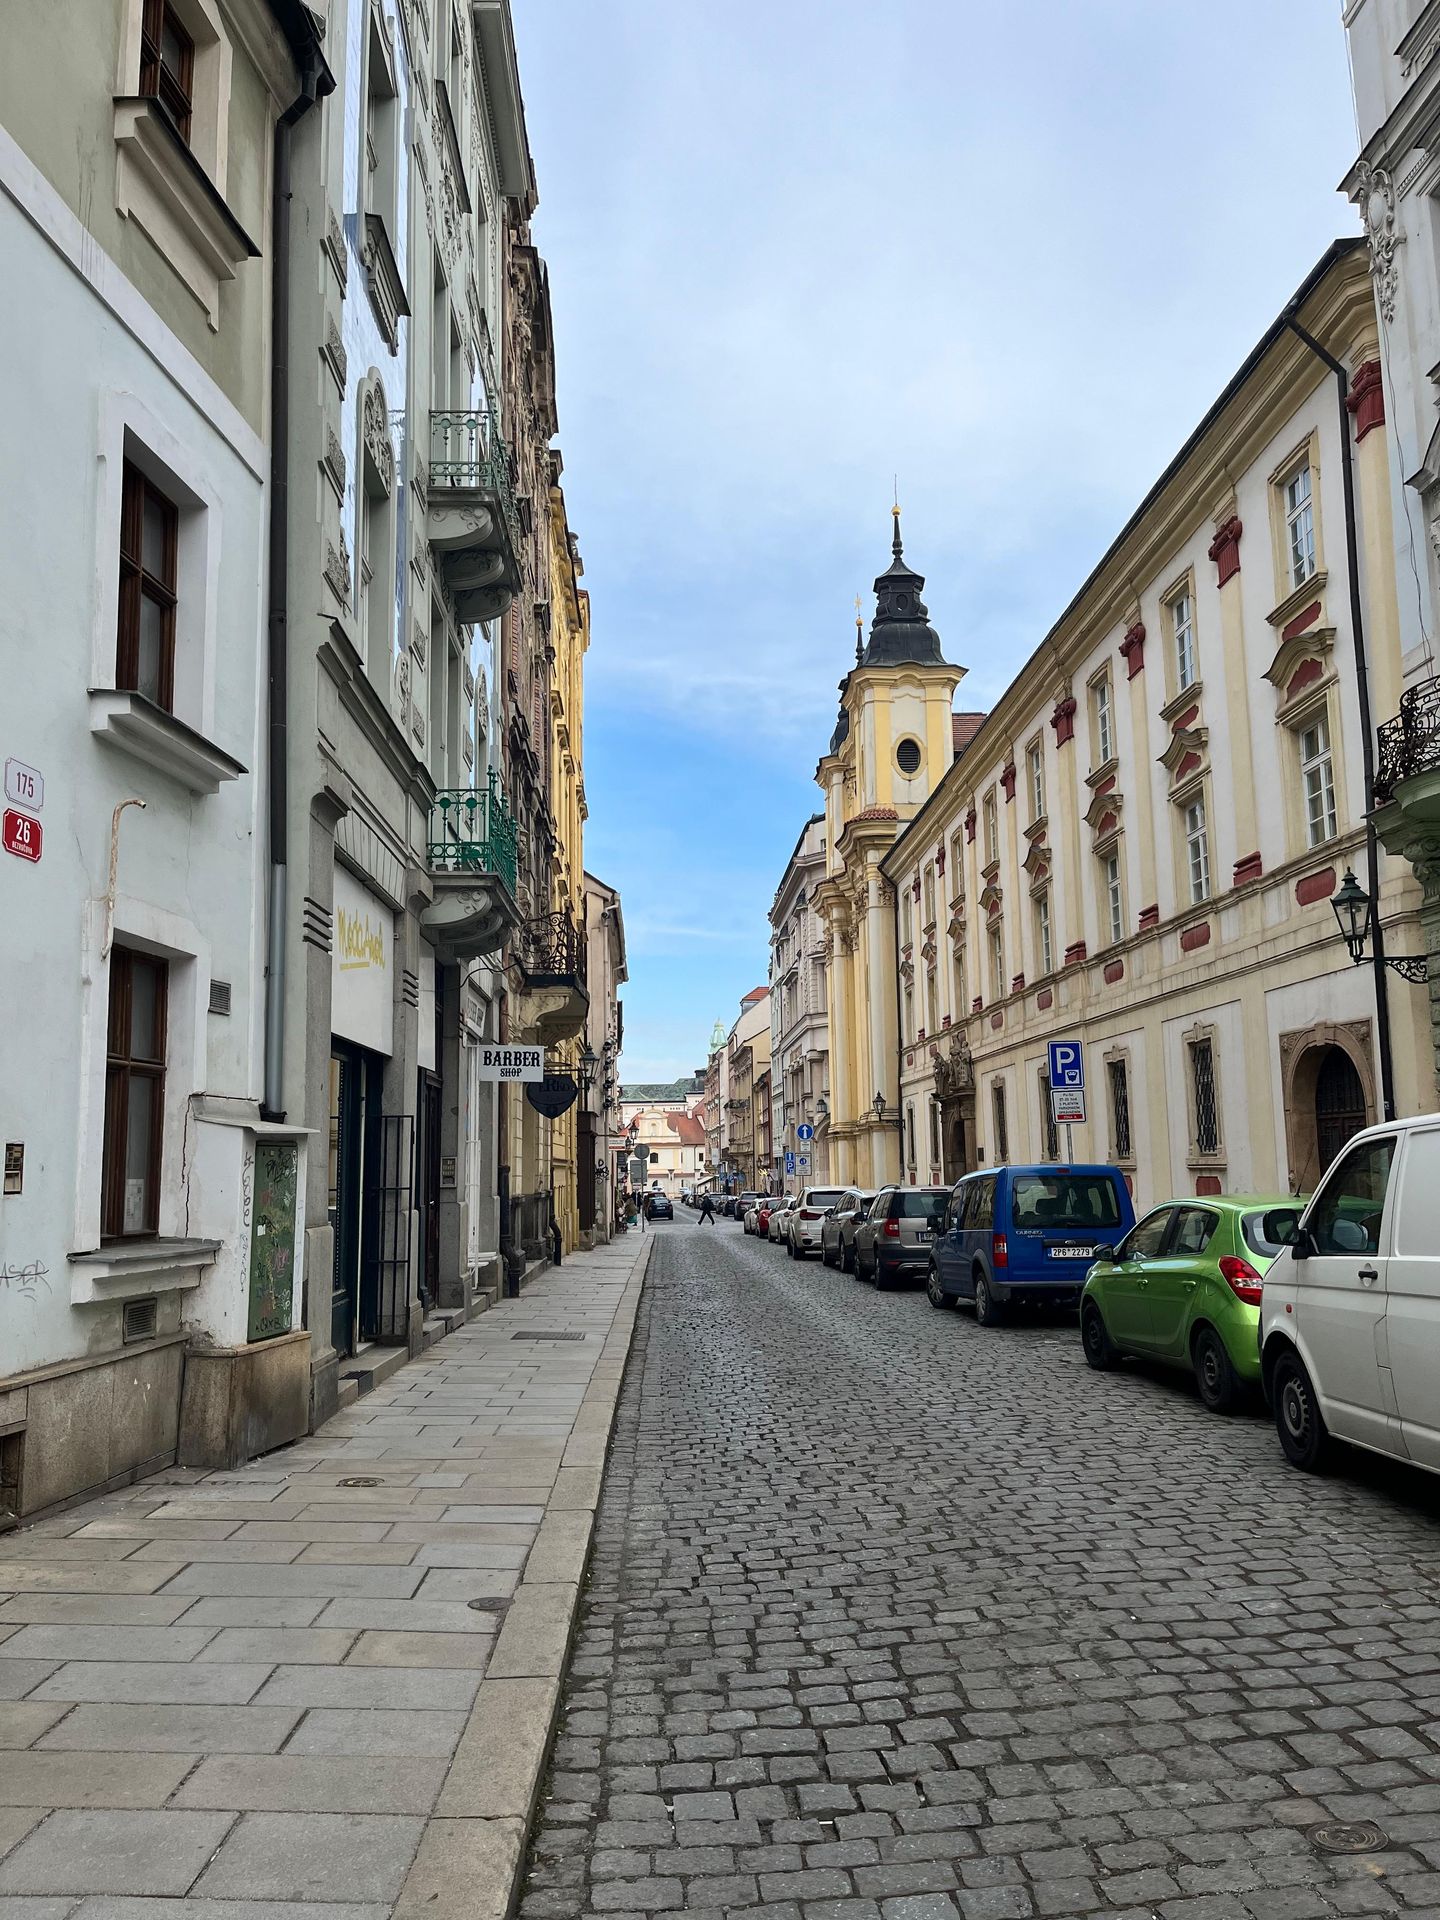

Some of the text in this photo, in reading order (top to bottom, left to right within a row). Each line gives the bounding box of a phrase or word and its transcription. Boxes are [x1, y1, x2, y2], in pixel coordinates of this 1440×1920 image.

[17, 772, 34, 798] 175
[16, 818, 30, 844] 26
[483, 1050, 540, 1067] BARBER
[1056, 1047, 1075, 1073] P
[500, 1068, 522, 1078] SHOP
[1053, 1248, 1090, 1257] 2P6 2279
